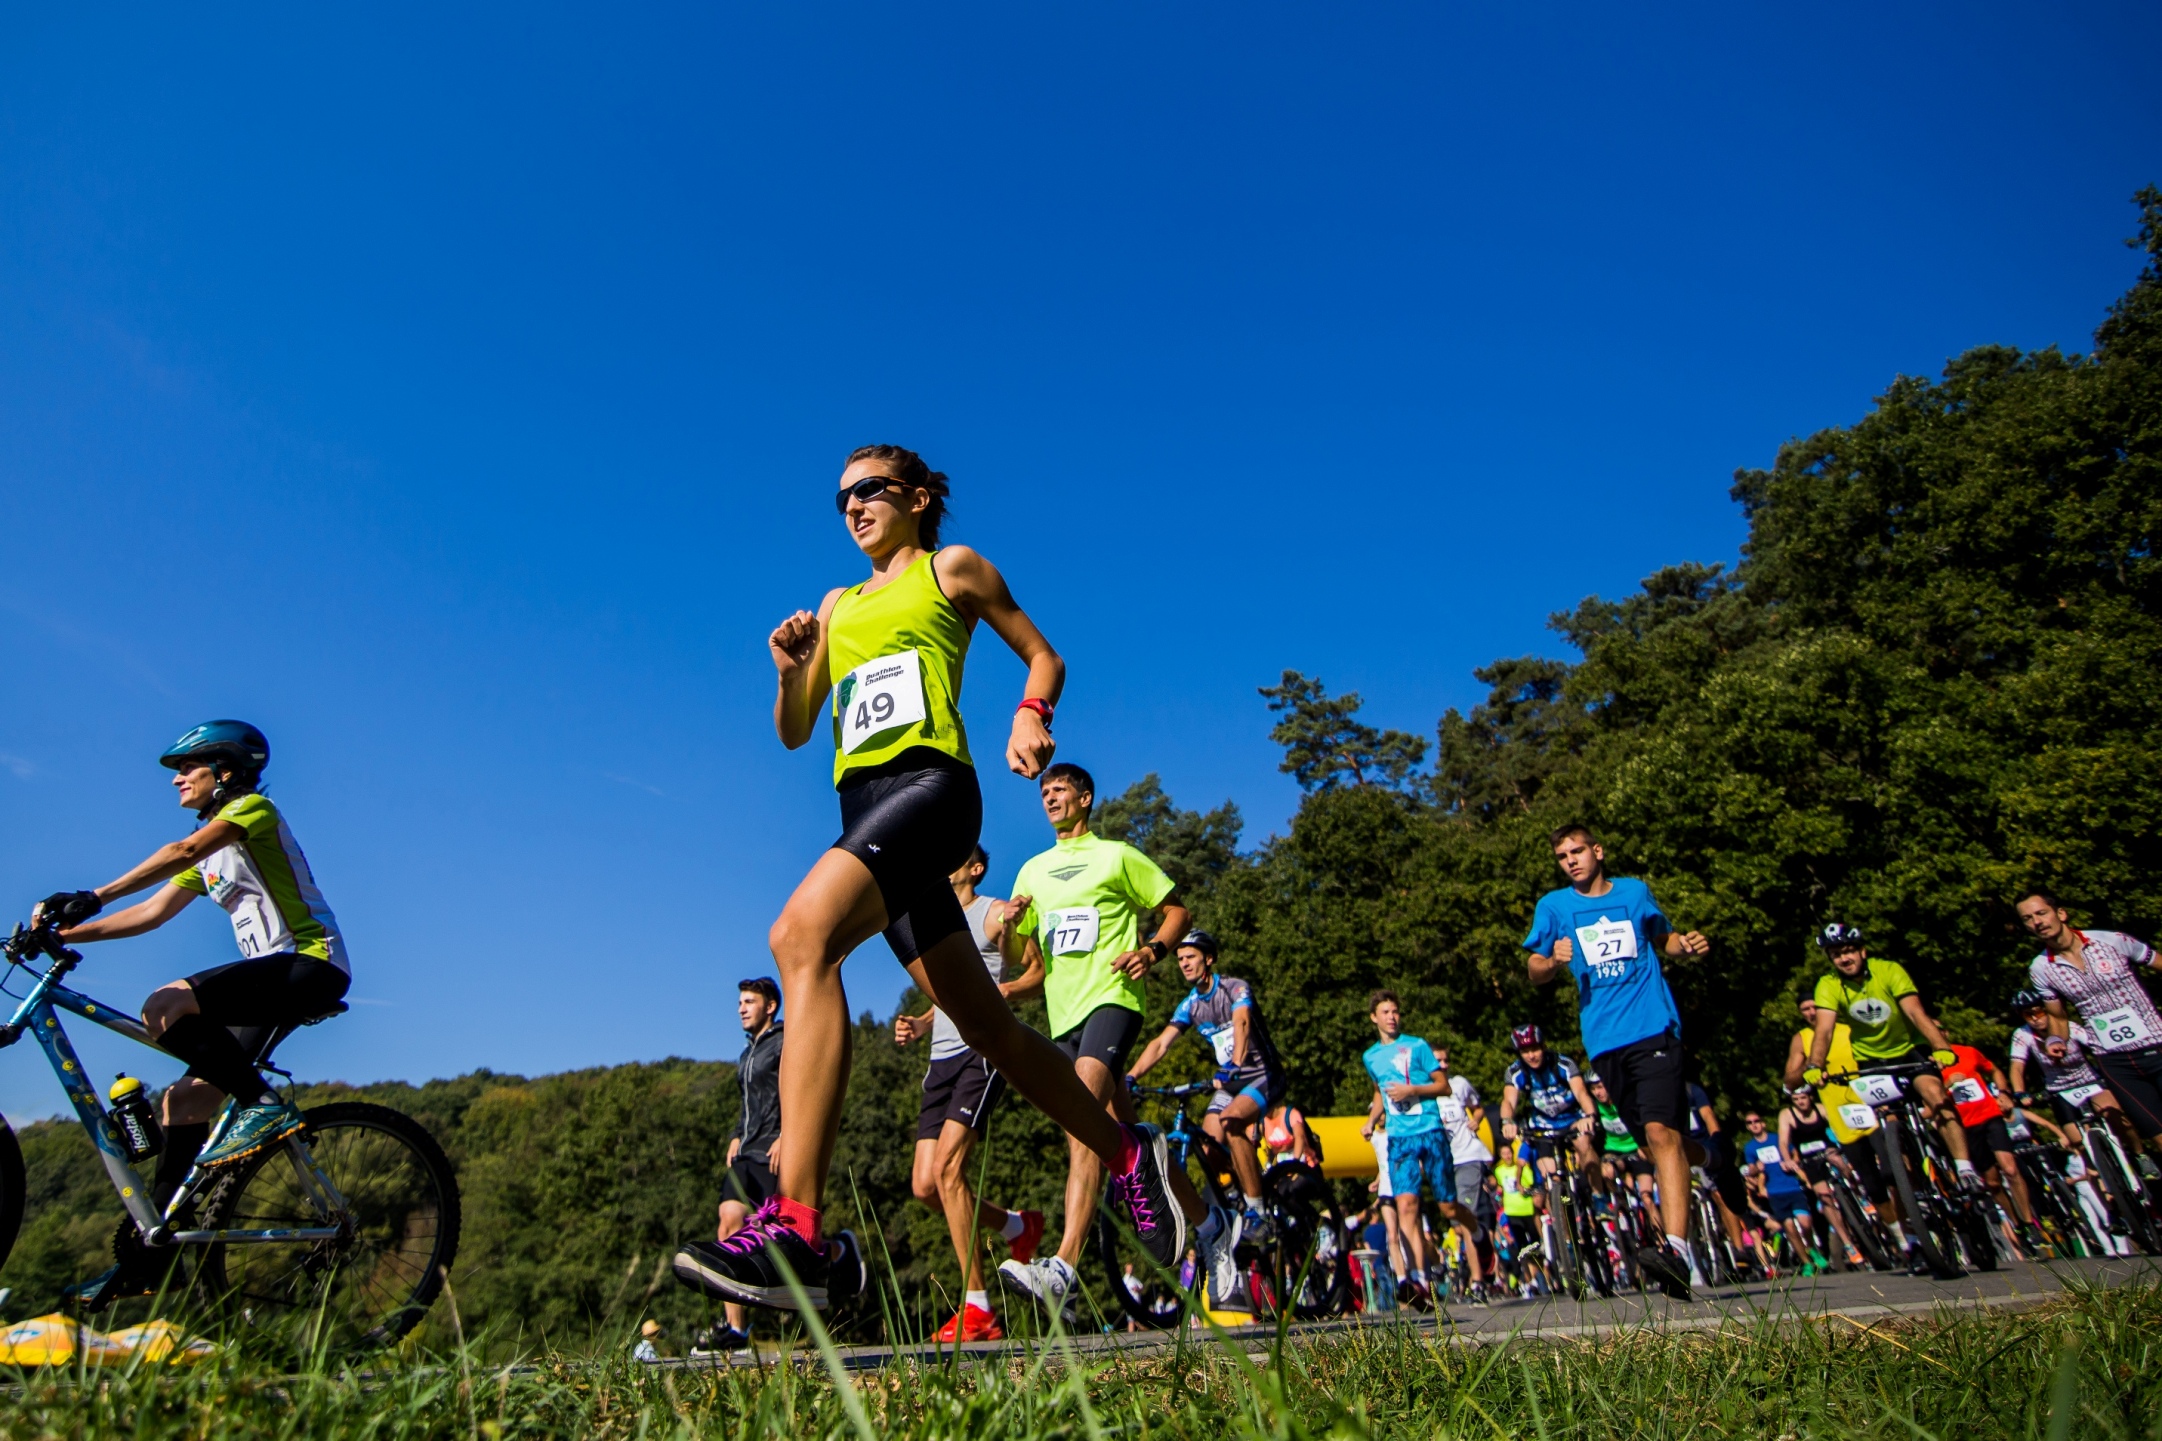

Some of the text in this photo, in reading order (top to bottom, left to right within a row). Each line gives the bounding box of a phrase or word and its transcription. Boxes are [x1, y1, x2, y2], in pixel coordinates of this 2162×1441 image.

[865, 669, 904, 686] Challenge
[855, 692, 895, 730] 49
[239, 933, 259, 958] 01
[1057, 928, 1081, 948] 77
[1597, 939, 1622, 957] 27
[2109, 1026, 2136, 1043] 68
[1869, 1087, 1888, 1101] 18
[1852, 1115, 1864, 1126] 18
